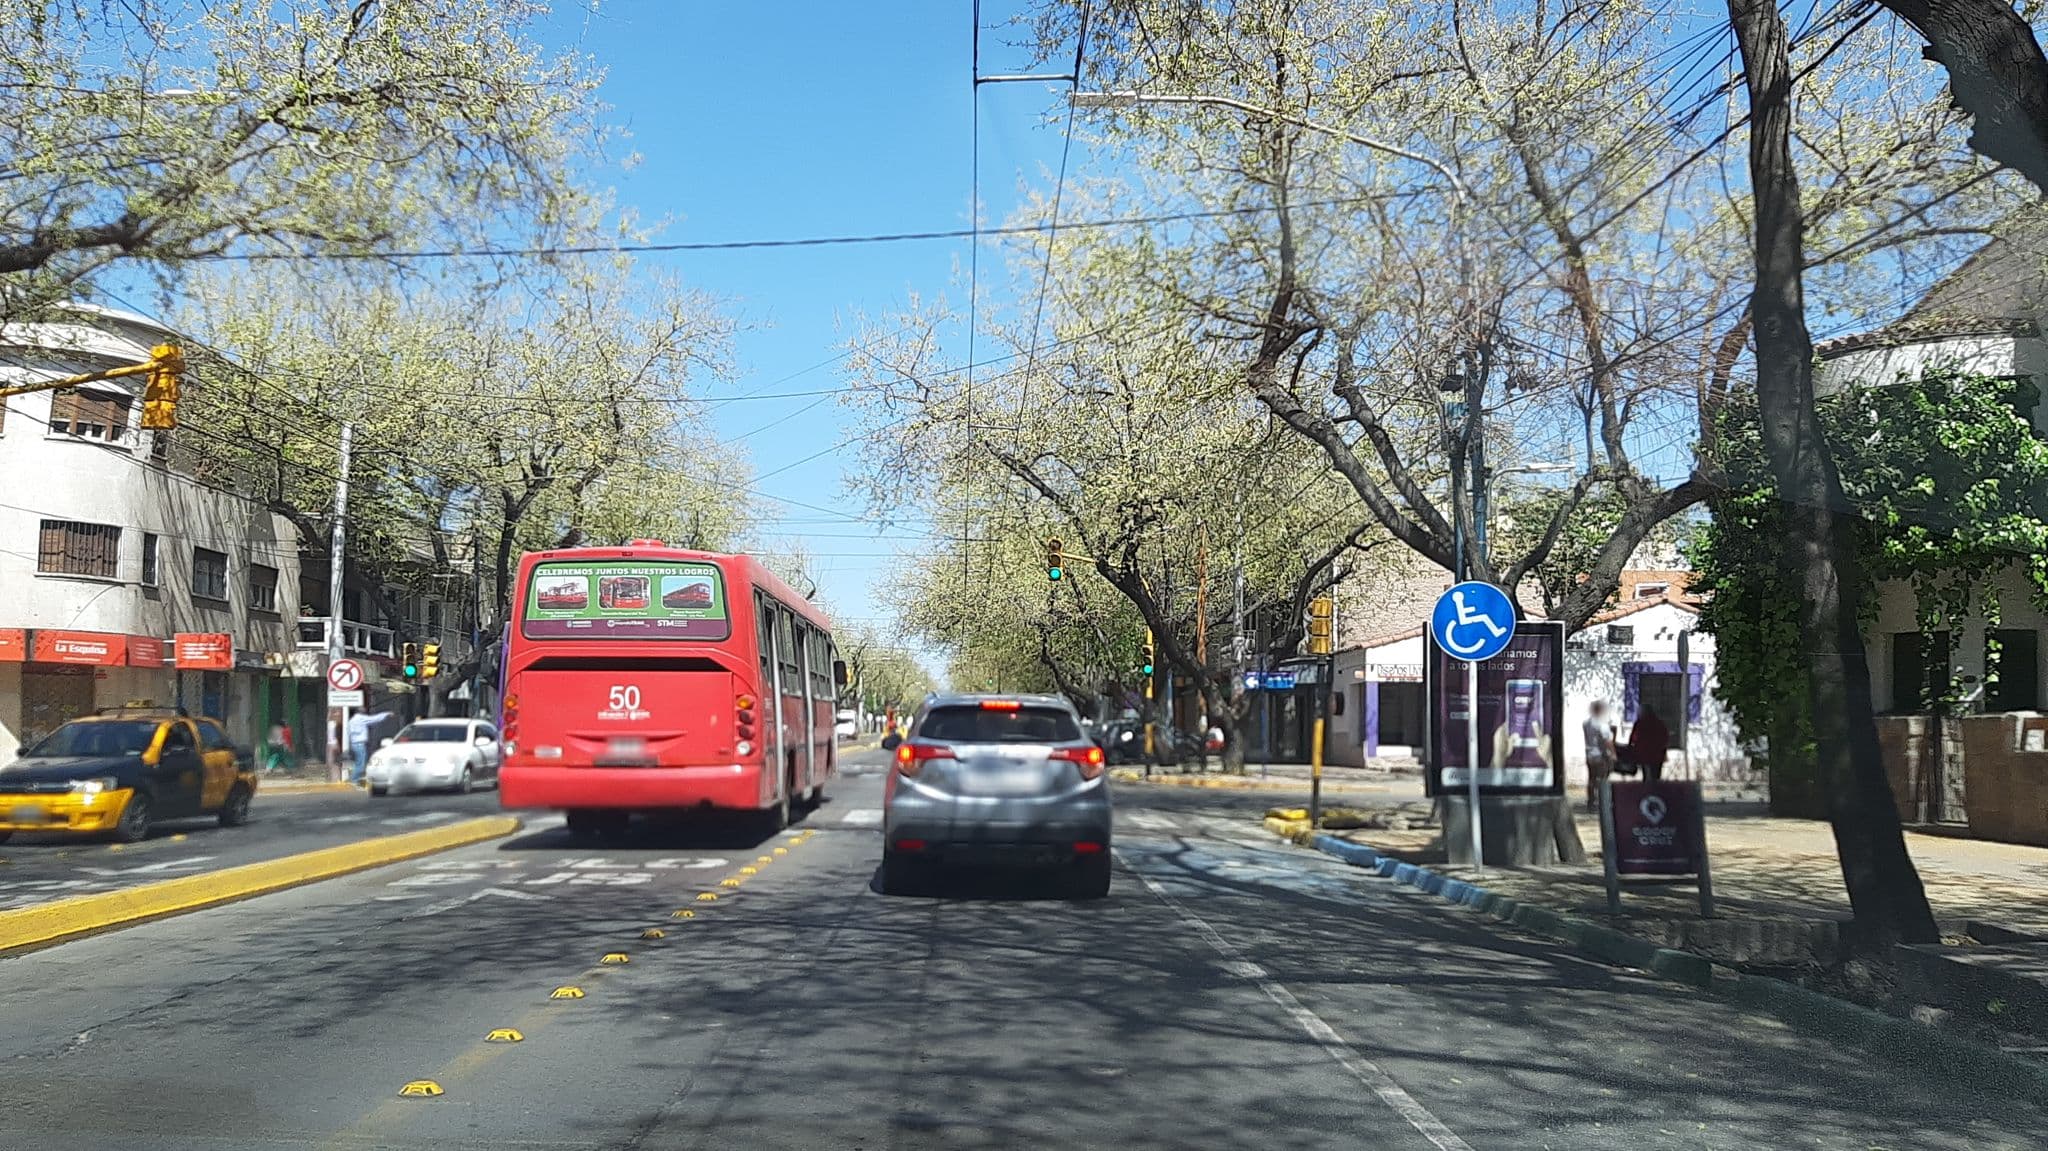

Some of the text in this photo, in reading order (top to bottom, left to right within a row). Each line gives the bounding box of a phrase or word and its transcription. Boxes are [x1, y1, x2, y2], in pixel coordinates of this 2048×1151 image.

[536, 567, 715, 576] CELEBREMOS JUNTOS NUESTROS LOGROS
[657, 619, 674, 627] STM
[55, 643, 67, 652] La
[69, 644, 108, 655] Esquina
[1488, 660, 1515, 671] lados
[609, 685, 641, 711] 50
